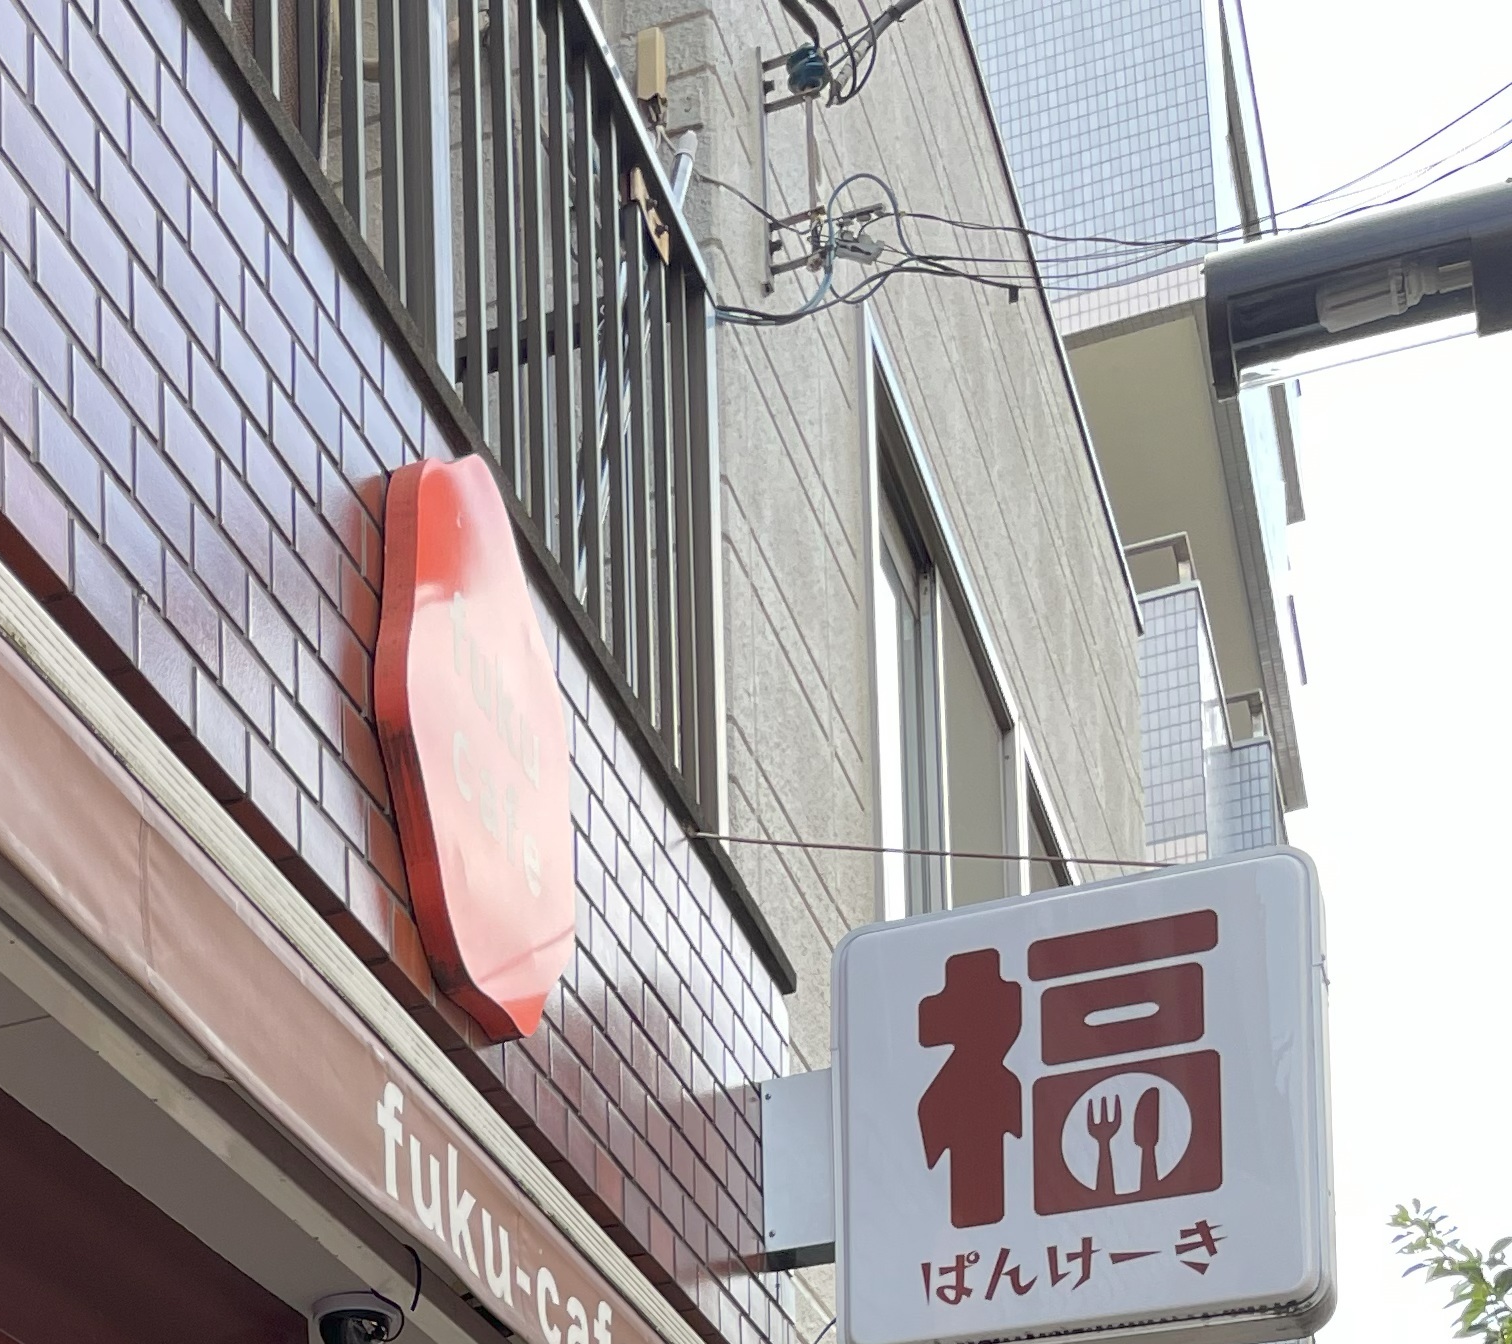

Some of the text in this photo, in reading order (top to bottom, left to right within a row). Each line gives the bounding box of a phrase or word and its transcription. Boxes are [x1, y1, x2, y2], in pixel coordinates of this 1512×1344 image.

[451, 591, 540, 789] fuku
[918, 908, 1223, 1229] 福
[921, 1219, 1228, 1306] ぱんけーき
